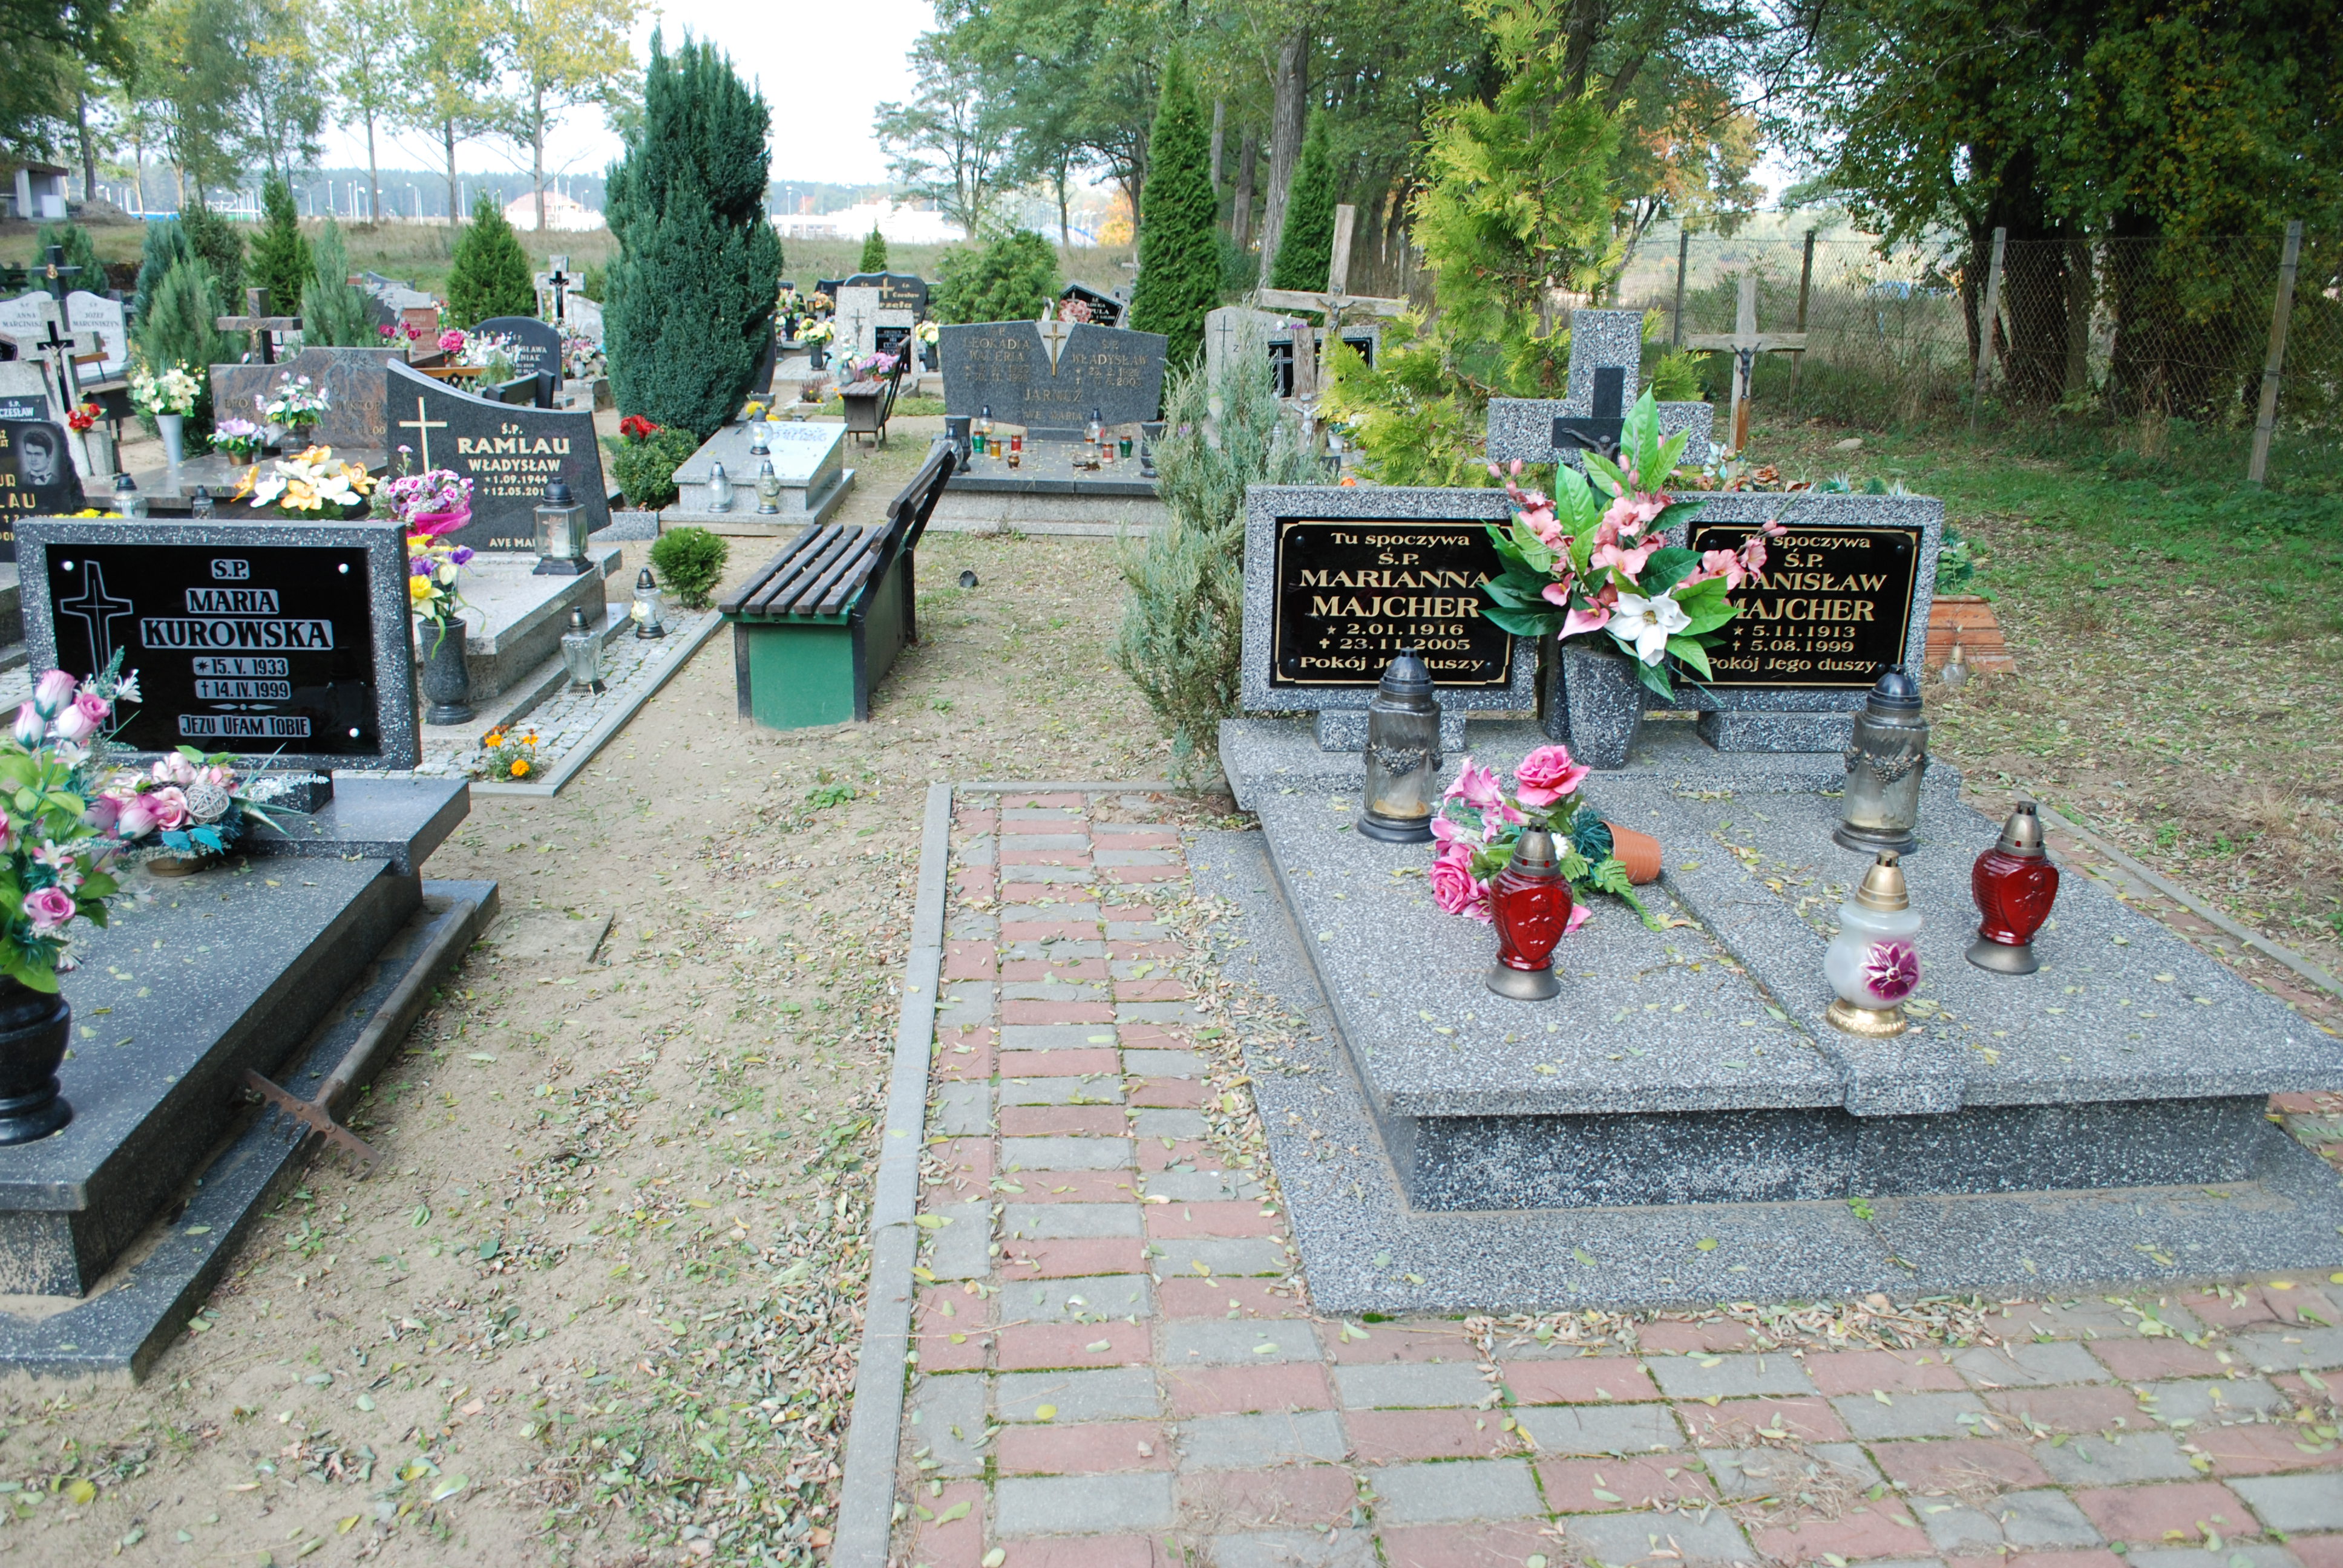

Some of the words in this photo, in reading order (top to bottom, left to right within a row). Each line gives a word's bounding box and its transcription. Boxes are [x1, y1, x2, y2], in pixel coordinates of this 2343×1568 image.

[965, 338, 1030, 350] LEOKADIA
[969, 350, 1024, 362] WALERIA
[1072, 354, 1147, 365] WŁADYSŁAW
[501, 423, 523, 435] Ś.P.
[457, 437, 571, 454] RAMLAU
[468, 459, 561, 472] WŁADYSŁAW
[493, 475, 549, 485] 1.09.1944
[492, 487, 545, 496] 12.05.201
[489, 538, 511, 547] AVE
[1331, 532, 1358, 544] Tu
[1365, 534, 1470, 547] spoczywa
[1772, 535, 1871, 550] spoczywa
[1378, 546, 1420, 565] Ś.P.
[1783, 548, 1824, 567] Ś.P.
[1299, 569, 1492, 589] MARIANNA
[1737, 572, 1887, 592] TANISŁAW
[188, 590, 279, 612] MARIA
[1311, 596, 1480, 618] MAJCHER
[143, 619, 332, 648] KUROWSKA
[1346, 624, 1464, 635] 2.01.1916
[1752, 625, 1856, 638] 5.11.1913
[1339, 638, 1471, 650] 23.11.2005
[1750, 639, 1854, 652] 5.08.1999
[1300, 656, 1366, 671] Pokój
[1706, 655, 1760, 673] Pokój
[1765, 657, 1812, 673] Jego
[1817, 658, 1878, 673] duszy
[181, 716, 216, 734] JEZU
[222, 716, 265, 735] UFAM
[268, 716, 309, 736] TOBIE
